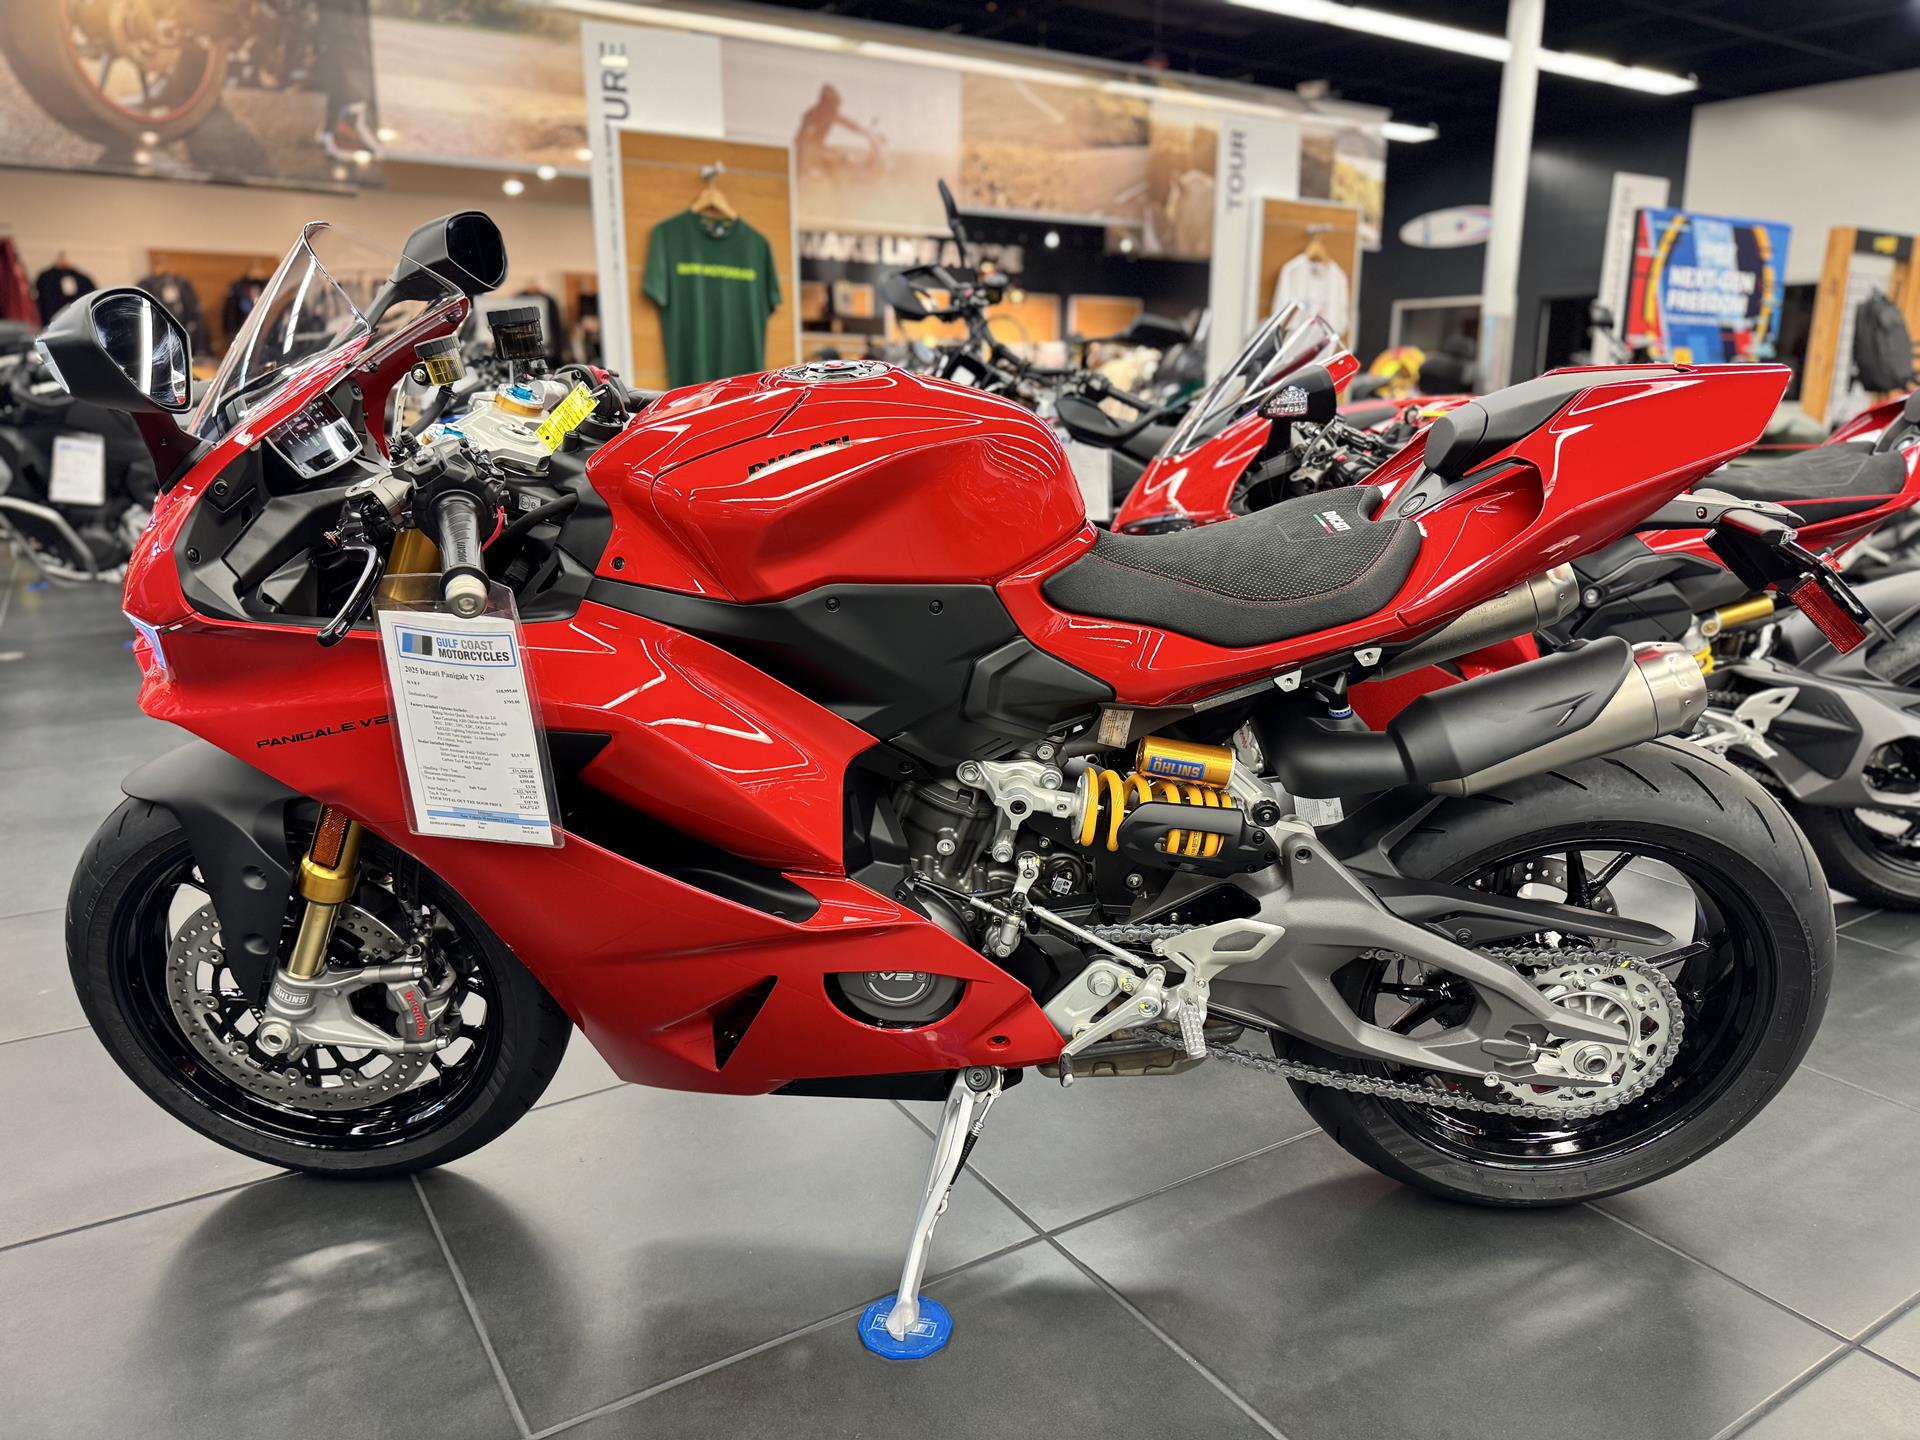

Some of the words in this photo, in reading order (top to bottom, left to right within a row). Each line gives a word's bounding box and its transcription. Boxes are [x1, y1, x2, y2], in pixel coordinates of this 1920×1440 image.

[1226, 130, 1248, 209] TOUR
[1321, 511, 1351, 531] DUCATI
[436, 637, 459, 649] GULF
[461, 639, 494, 651] COAST
[438, 648, 510, 662] MOTORCYCLES
[404, 666, 418, 674] 2025
[420, 668, 440, 678] Ducati
[441, 671, 468, 681] Panigale
[256, 722, 357, 749] PANIGALE
[1153, 757, 1201, 778] ÖHLINS
[880, 972, 914, 981] V2
[404, 991, 429, 1037] brembo
